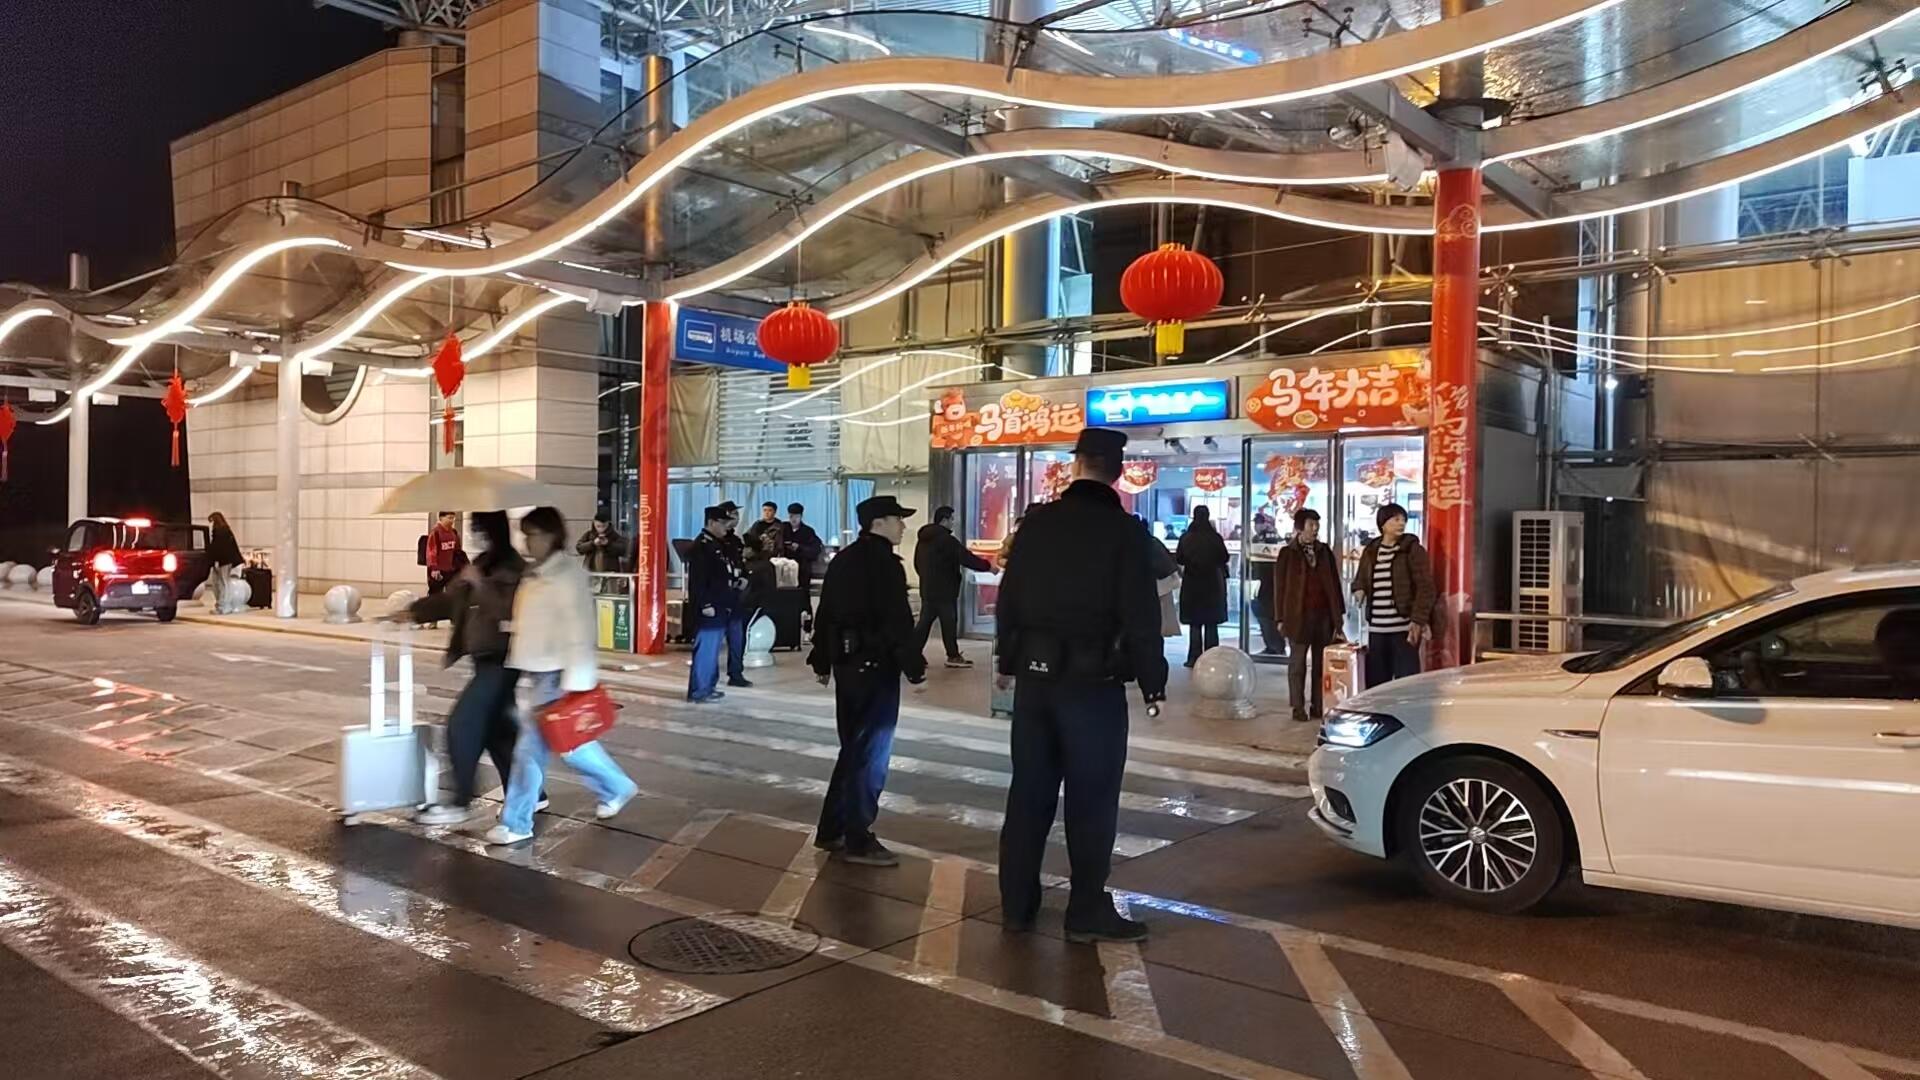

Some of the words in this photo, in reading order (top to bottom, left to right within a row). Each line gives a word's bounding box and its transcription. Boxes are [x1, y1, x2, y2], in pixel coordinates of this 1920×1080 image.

[726, 347, 750, 357] Airport
[1263, 363, 1401, 417] 马年大吉
[975, 402, 1083, 441] 马首鸿运
